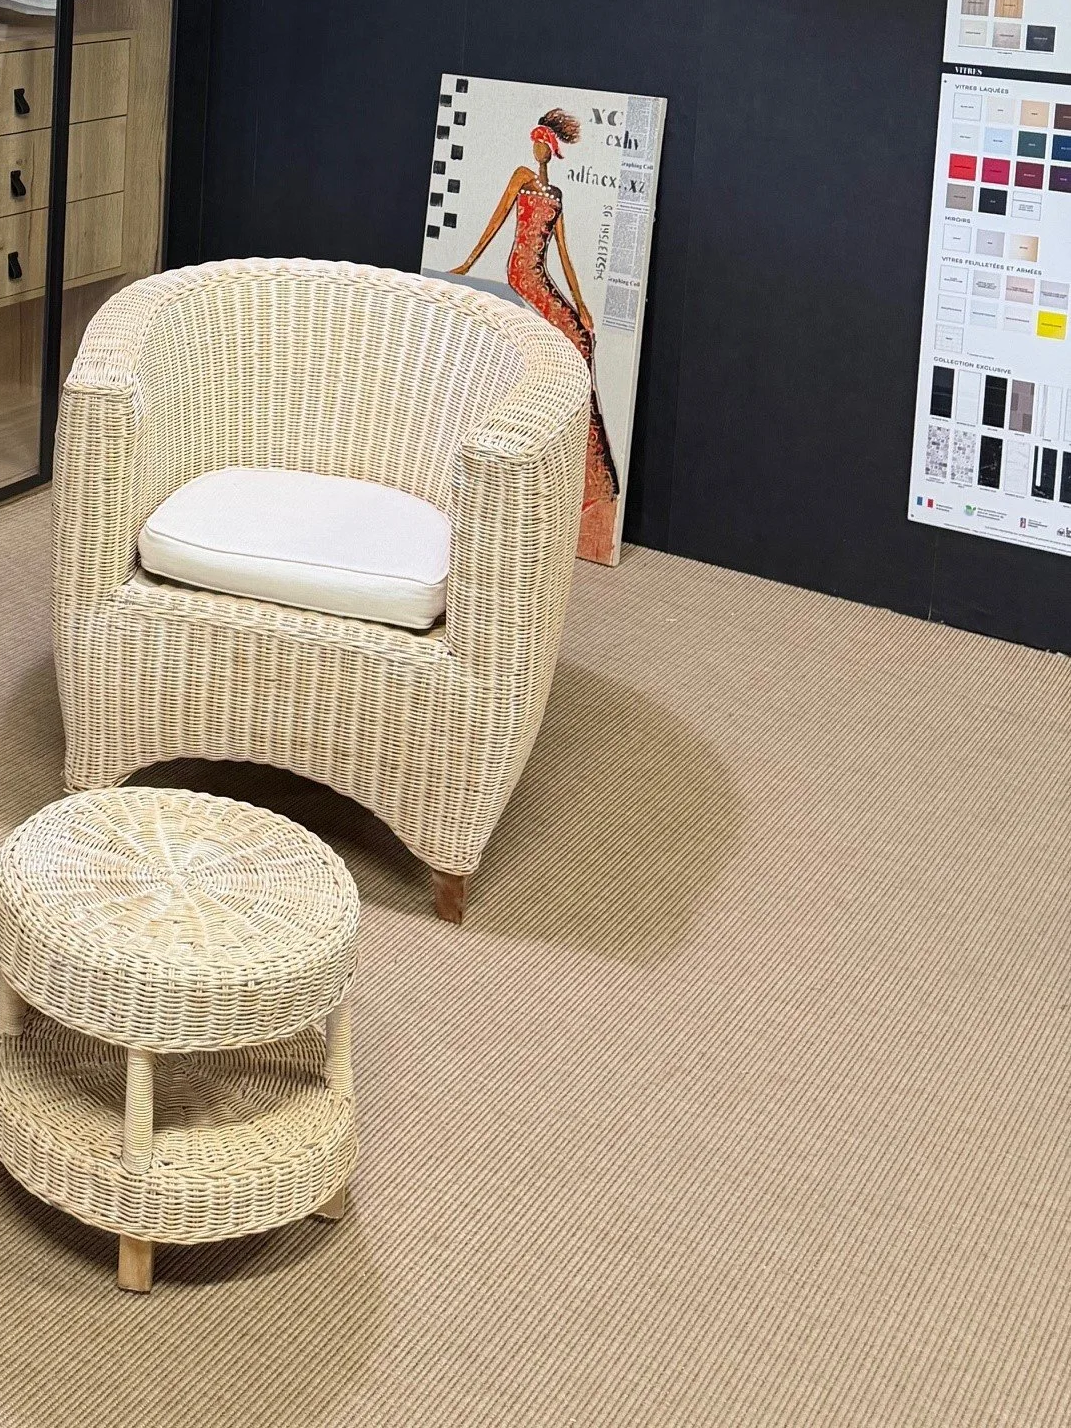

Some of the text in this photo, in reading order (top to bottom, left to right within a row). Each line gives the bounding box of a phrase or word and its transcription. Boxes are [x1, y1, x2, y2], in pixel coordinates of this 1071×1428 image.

[955, 66, 983, 75] VITRES
[979, 86, 1009, 94] LAQUÉES
[941, 256, 963, 264] VITRES
[965, 259, 1004, 270] FEUILLETÉES
[1016, 267, 1042, 275] ARMÉES
[933, 356, 1012, 374] COLLECTION EXCLUSIVE
